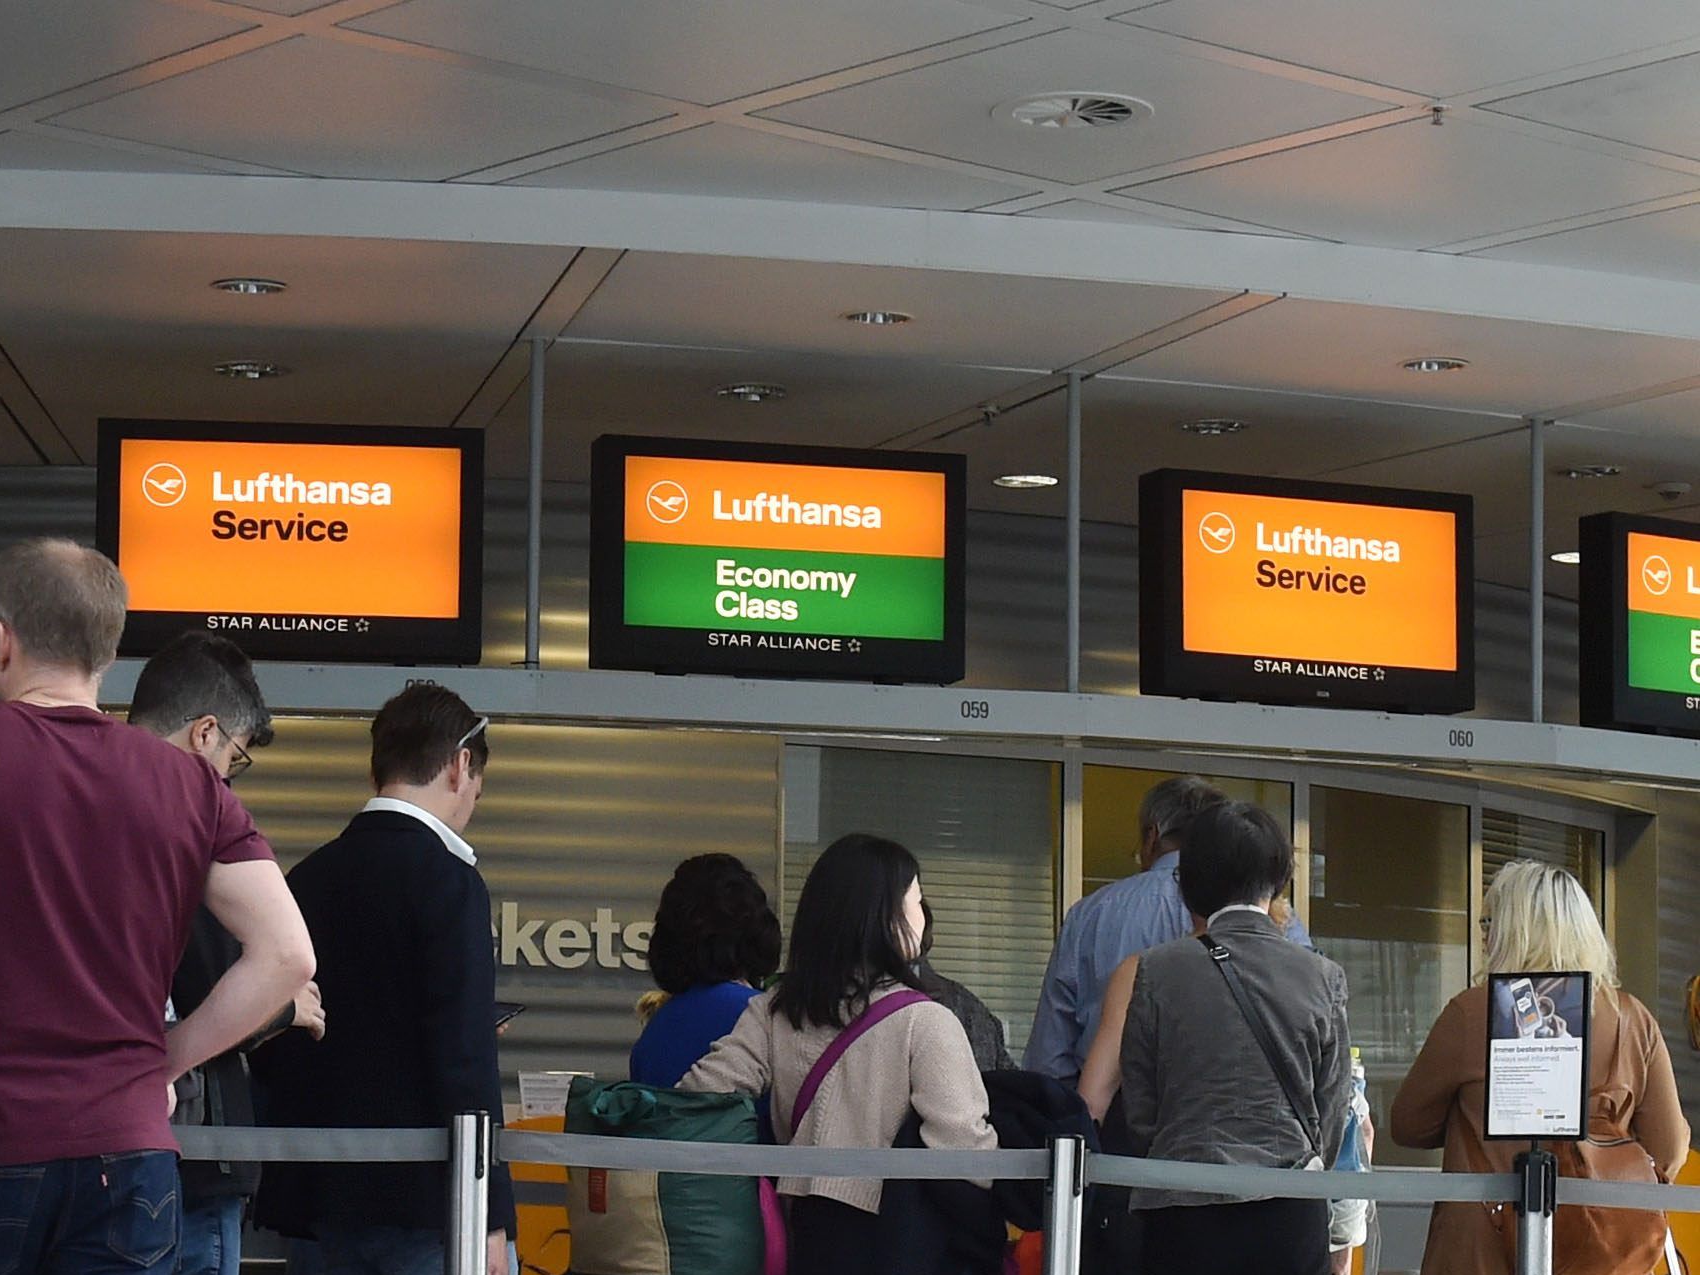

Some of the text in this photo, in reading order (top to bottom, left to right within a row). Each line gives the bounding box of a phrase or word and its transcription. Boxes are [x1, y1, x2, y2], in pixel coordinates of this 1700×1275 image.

[212, 472, 392, 506] Lufthansa
[713, 491, 882, 529] Lufthansa
[211, 511, 349, 542] Service
[1256, 522, 1401, 562] Lufthansa
[716, 559, 857, 598] Economy
[1256, 559, 1367, 595] Service
[715, 590, 799, 621] Class
[207, 616, 348, 632] STAR ALLIANCE
[707, 633, 842, 652] STAR ALLIANCE
[1253, 659, 1369, 680] STAR ALLIANCE
[960, 700, 990, 719] 059
[1449, 729, 1474, 748] 060
[491, 901, 656, 971] kets
